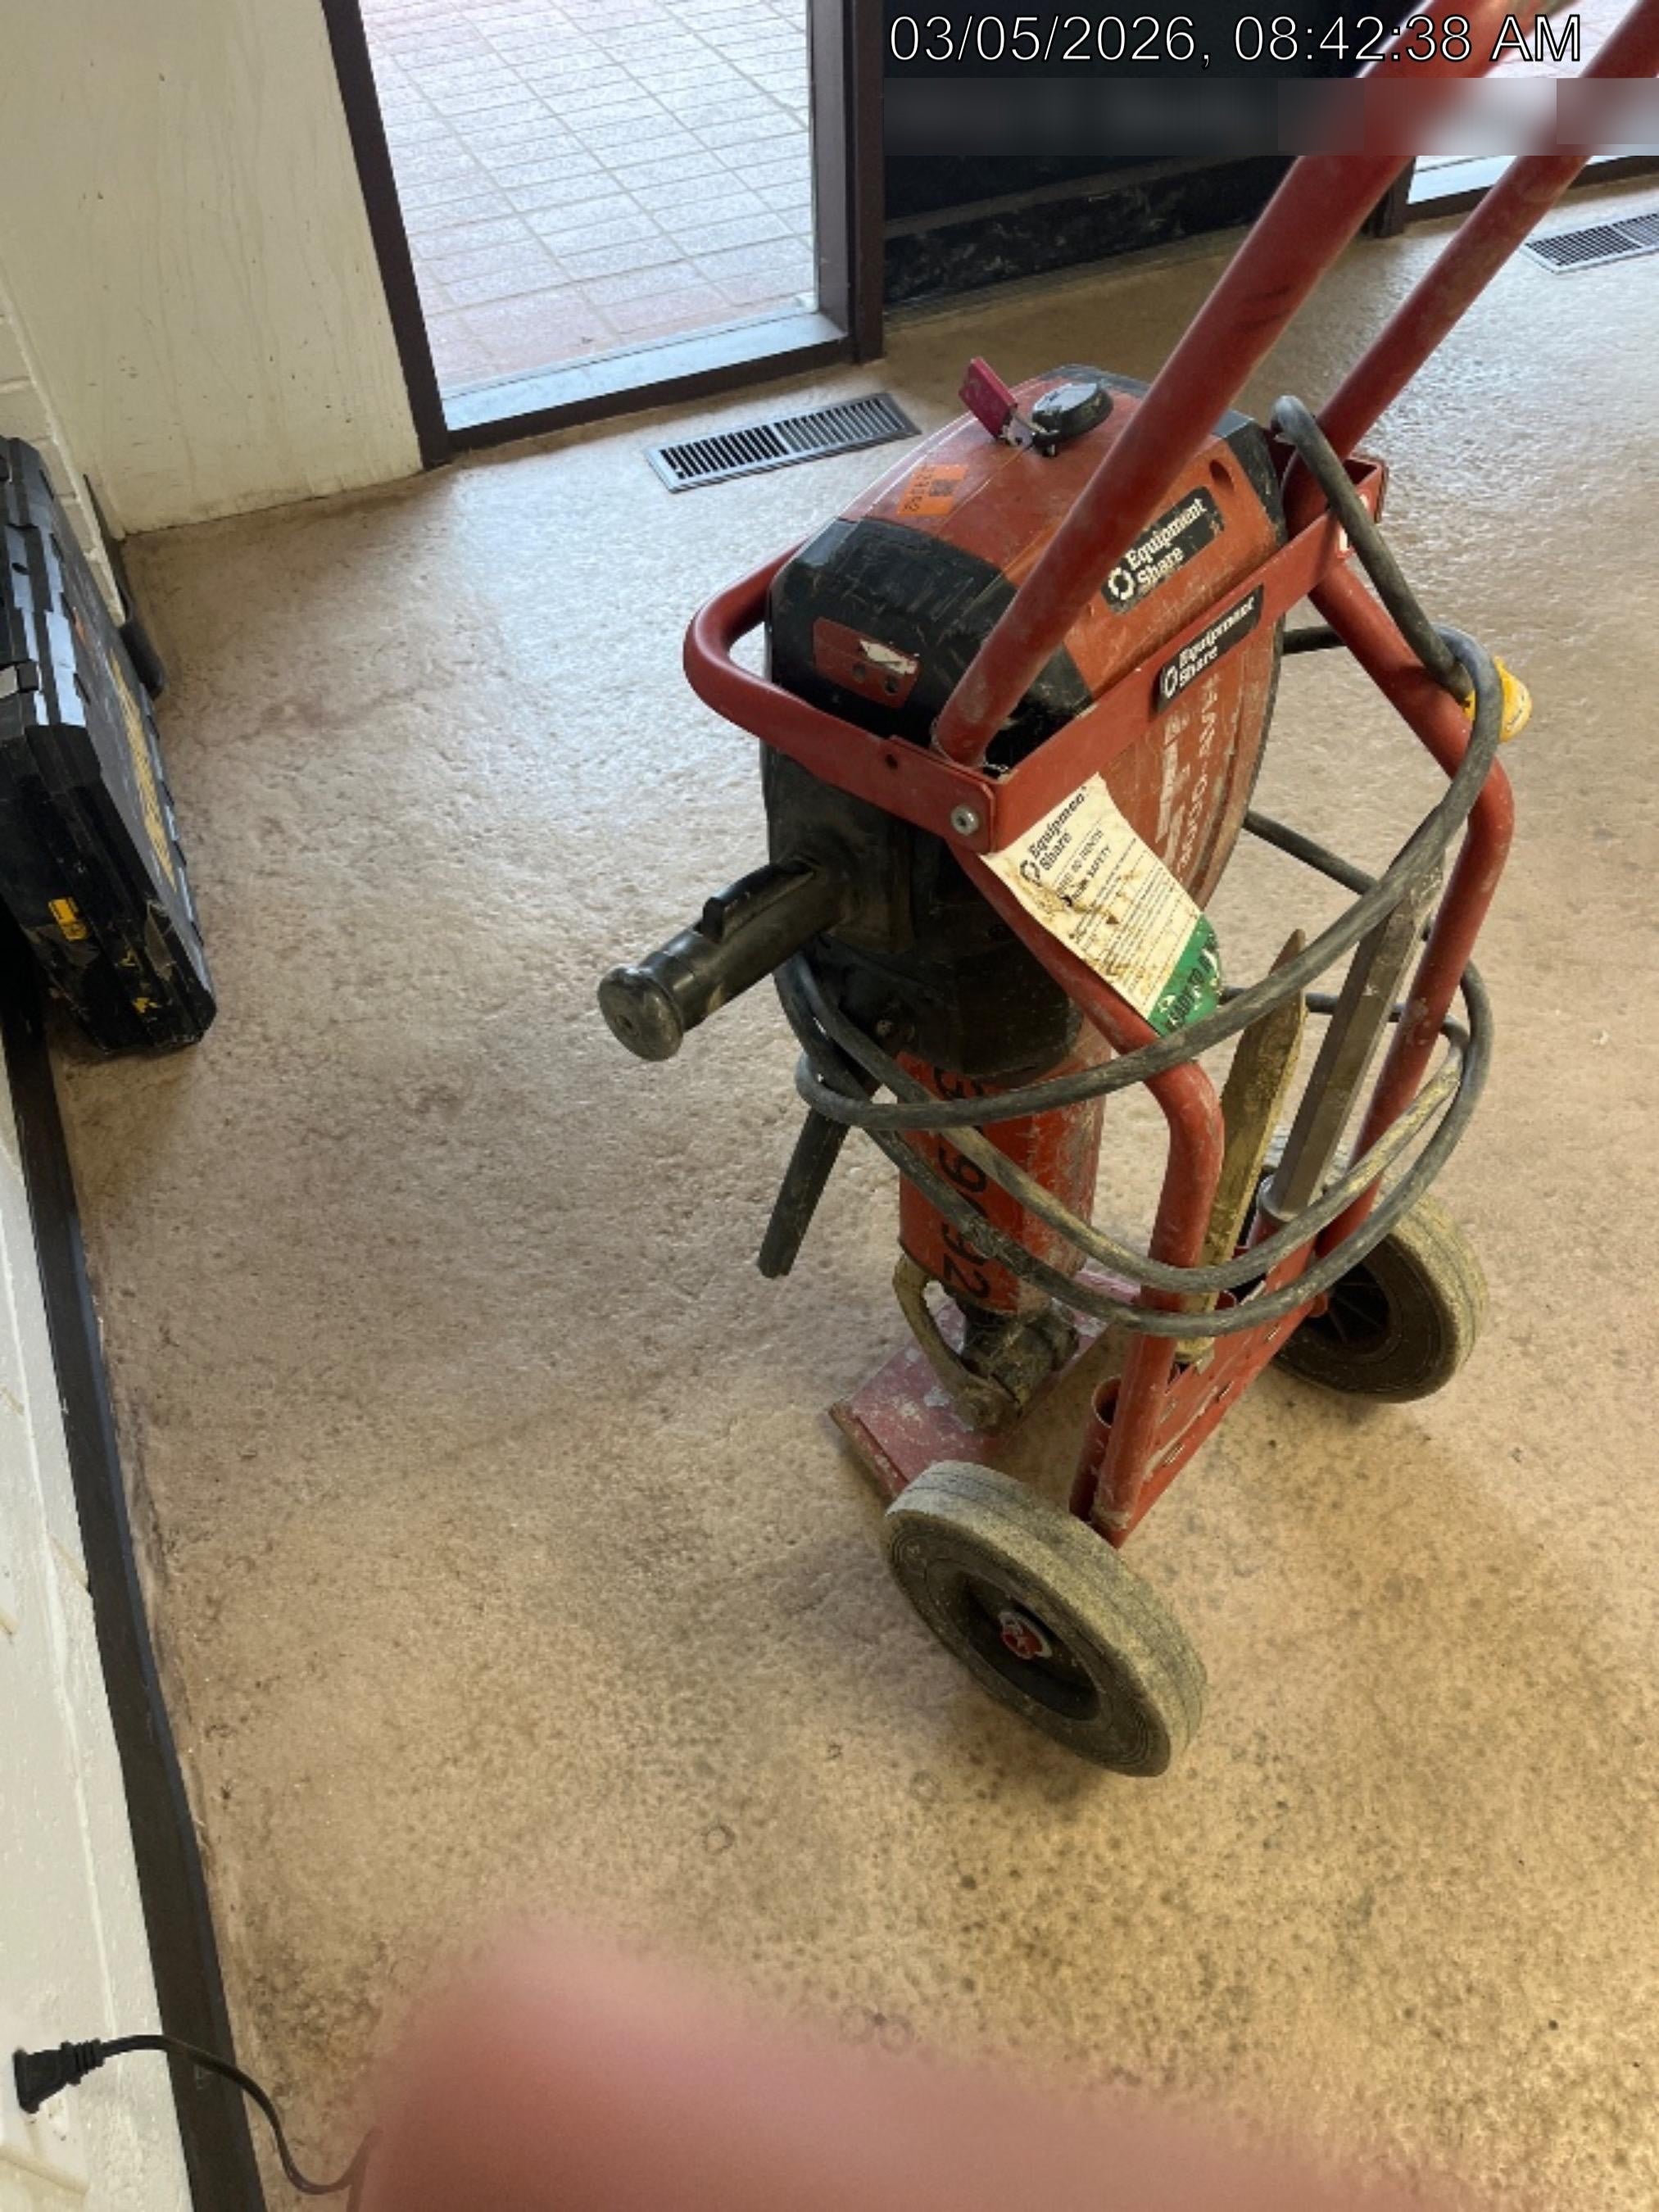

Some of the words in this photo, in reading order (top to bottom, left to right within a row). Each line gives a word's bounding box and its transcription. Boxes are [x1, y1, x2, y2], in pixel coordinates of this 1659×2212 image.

[1126, 497, 1208, 570] Equipment
[1137, 547, 1184, 586] Share
[1180, 596, 1254, 669] Equipment
[1180, 645, 1217, 688] Share
[1040, 832, 1072, 871] Share
